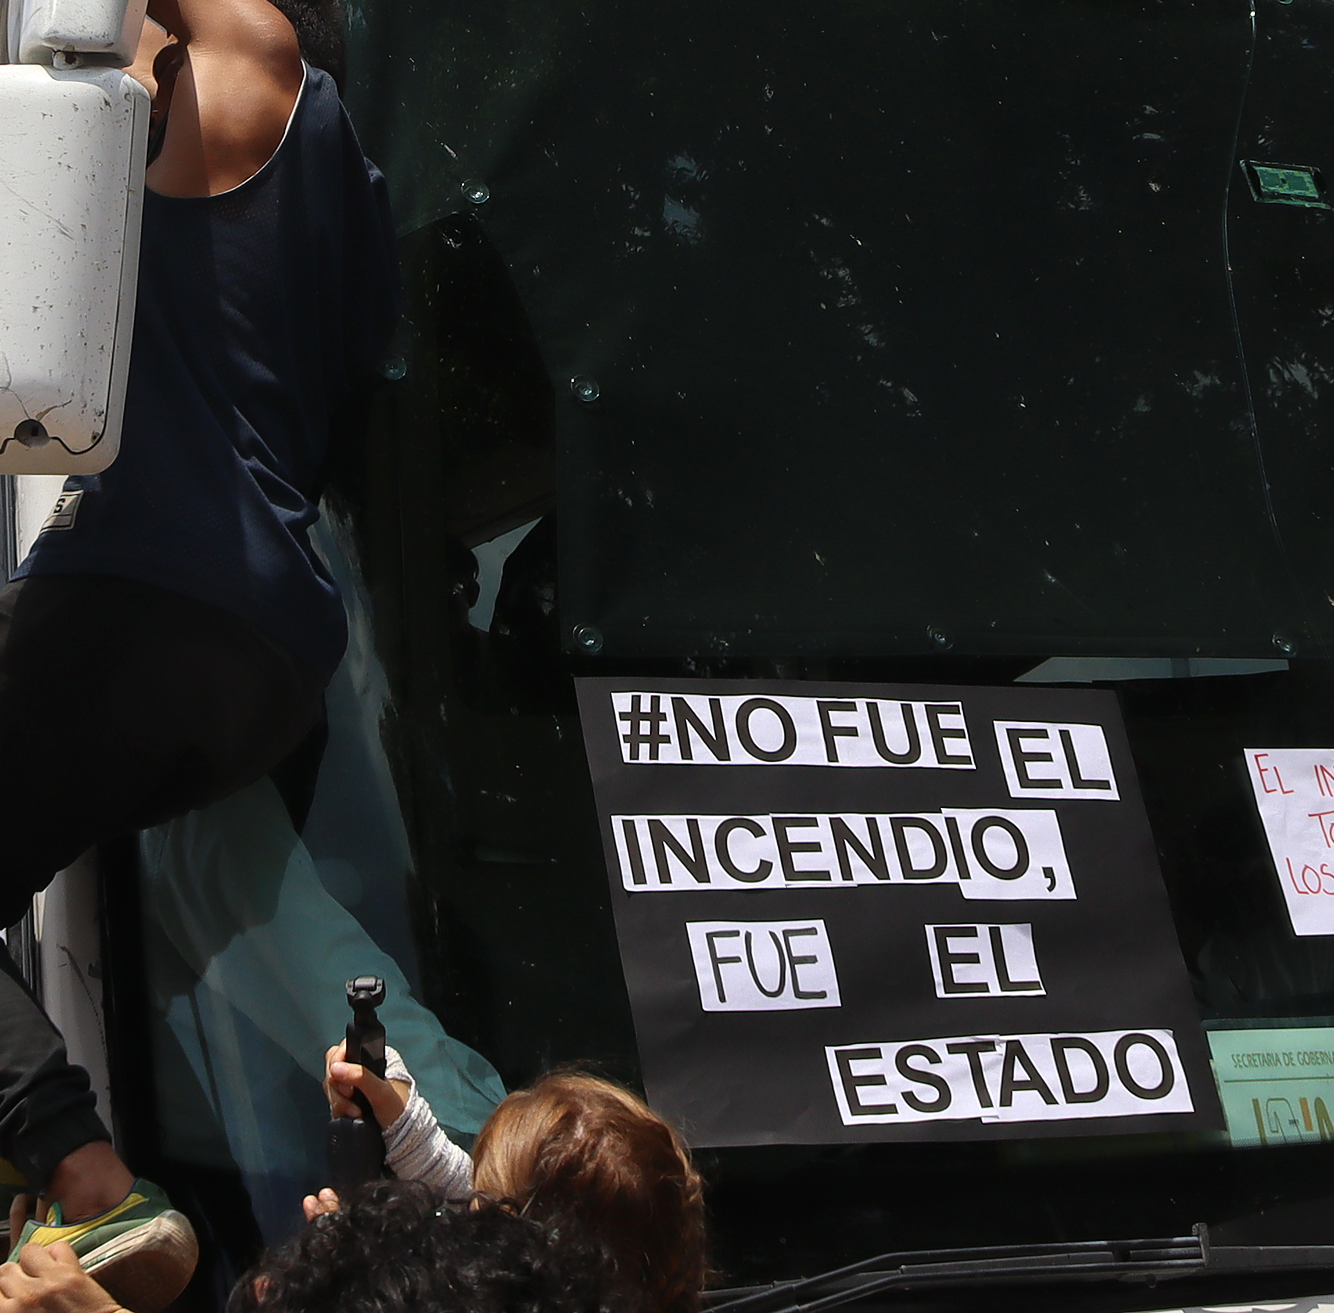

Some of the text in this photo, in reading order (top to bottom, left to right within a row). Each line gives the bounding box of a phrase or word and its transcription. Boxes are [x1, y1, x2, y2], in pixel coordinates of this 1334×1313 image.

[618, 694, 1112, 791] #NO FUE EL
[1254, 753, 1294, 795] EL
[622, 815, 1058, 893] INCENDIO,
[705, 925, 1042, 1003] FUE EL
[835, 1032, 1176, 1117] ESTADO
[1231, 1052, 1282, 1068] SECRETARIA
[1282, 1051, 1296, 1066] DE
